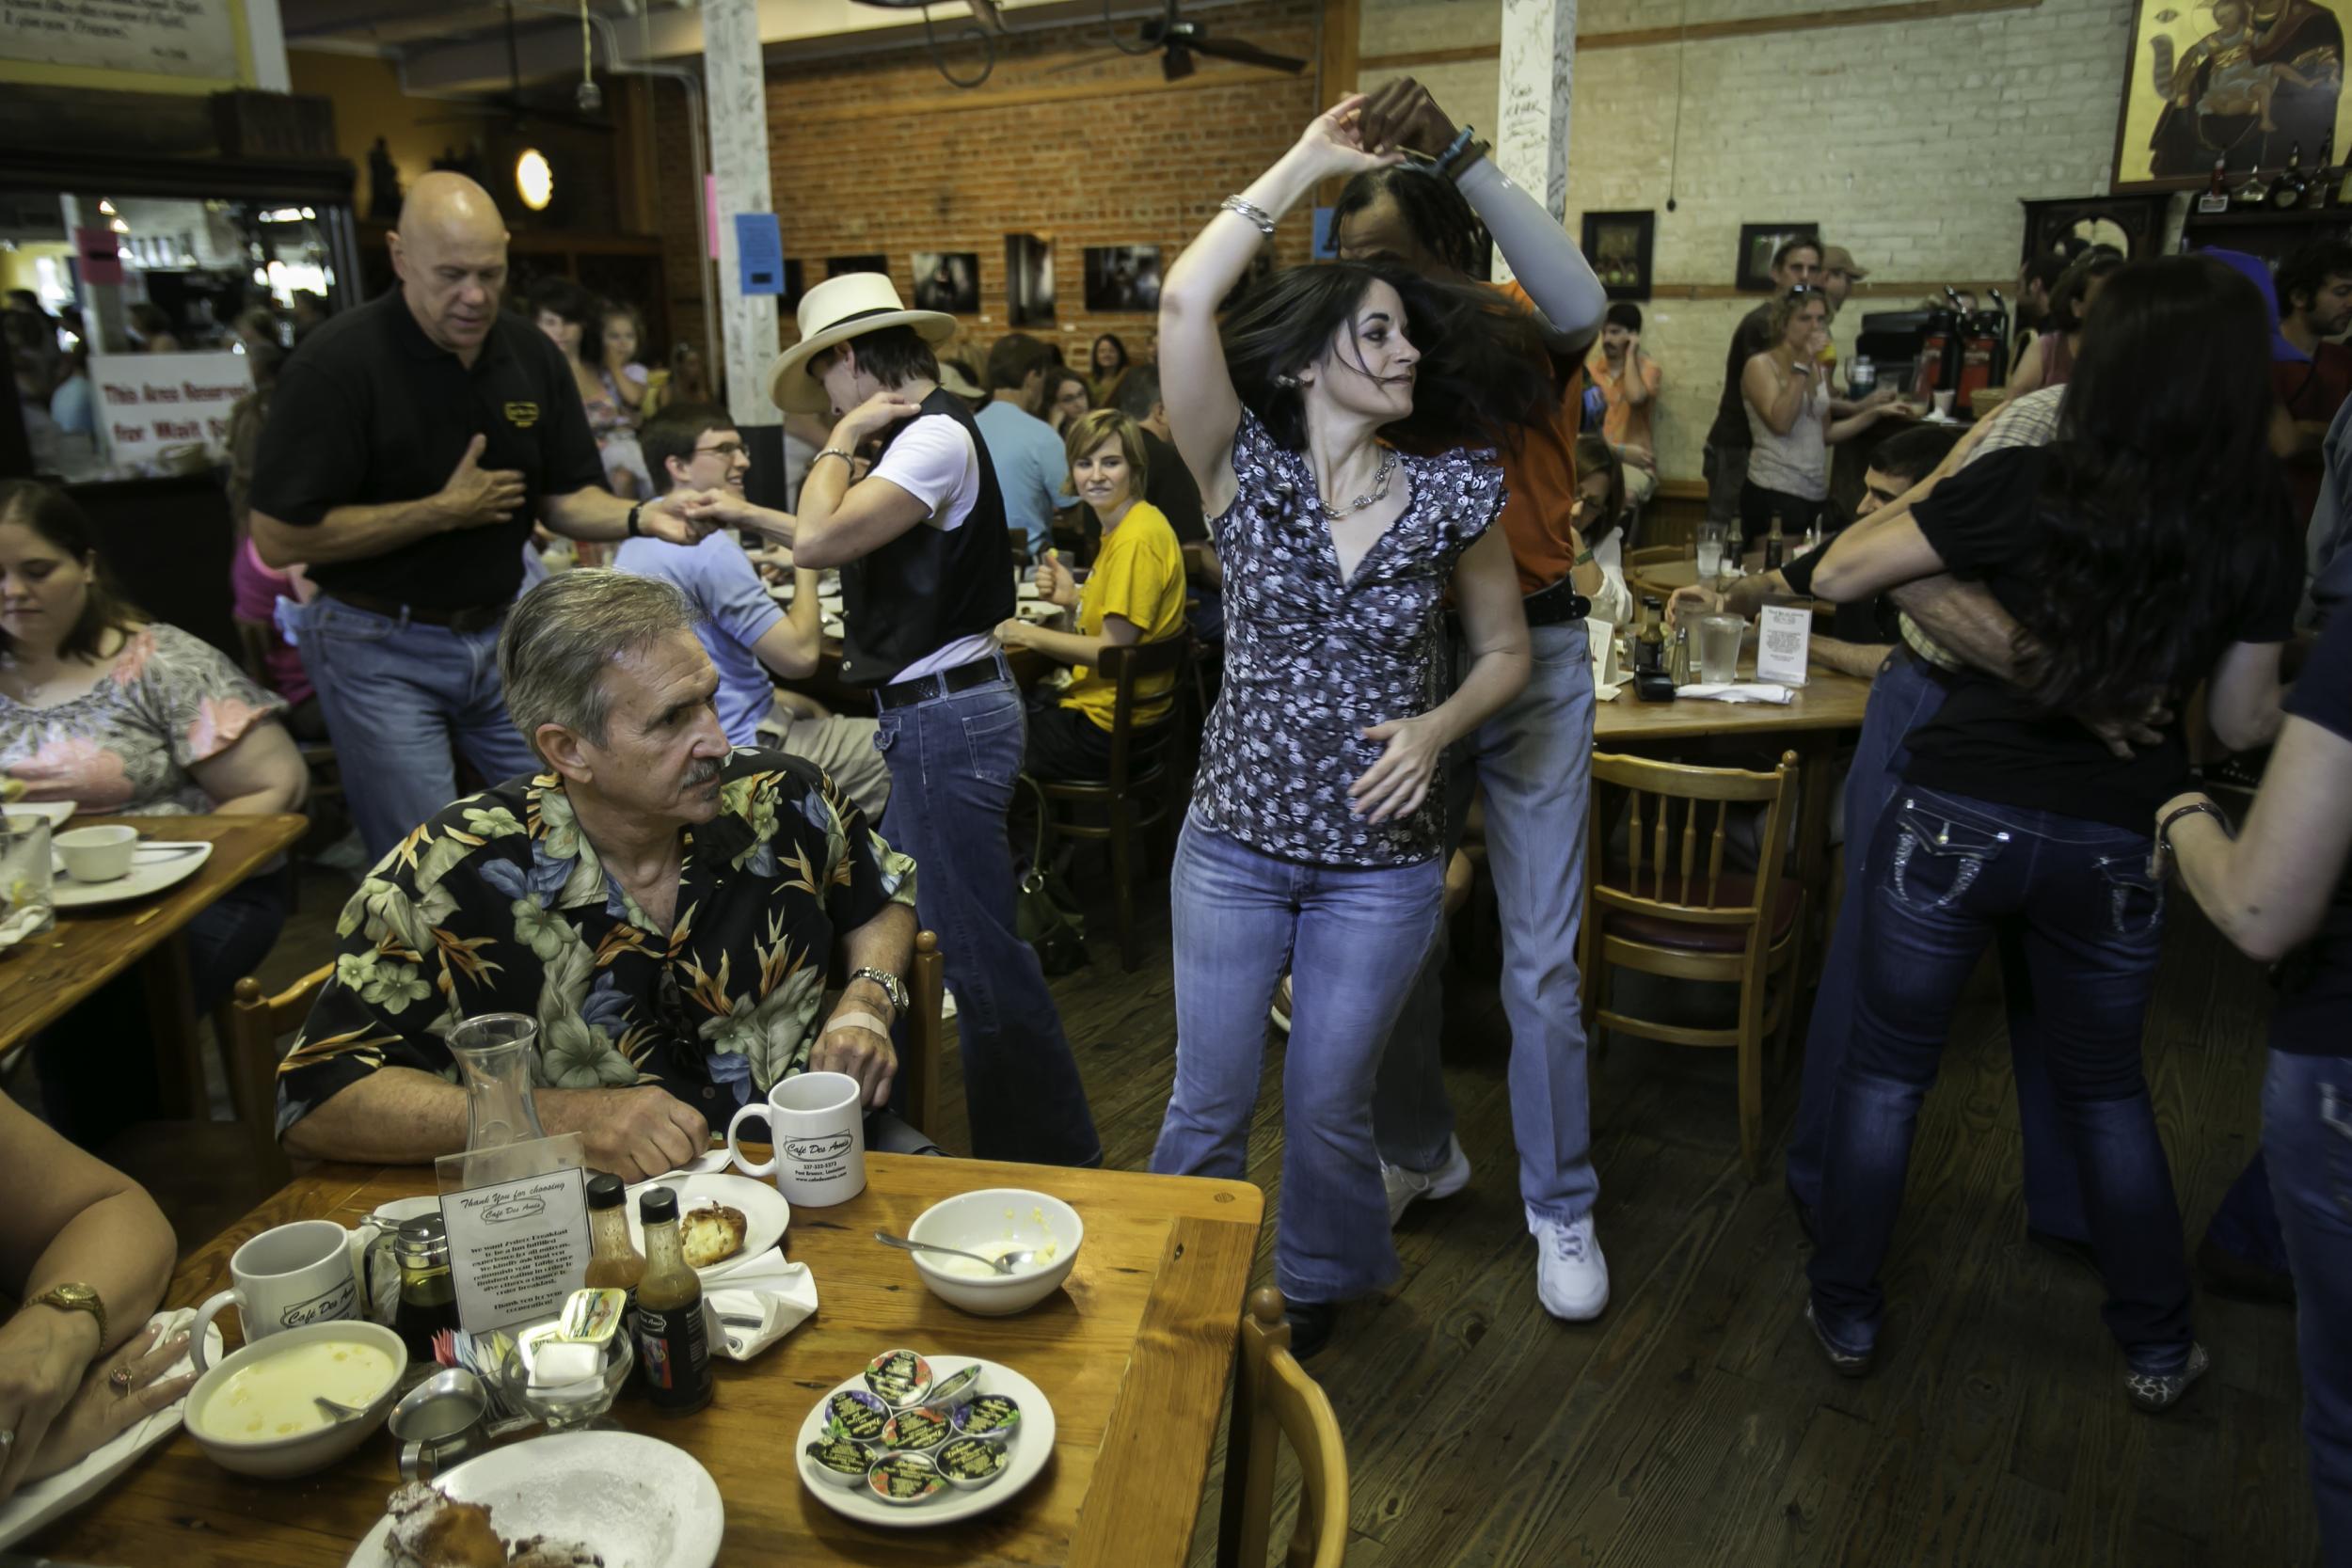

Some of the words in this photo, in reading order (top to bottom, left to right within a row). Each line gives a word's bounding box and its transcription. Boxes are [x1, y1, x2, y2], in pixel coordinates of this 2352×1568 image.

[103, 383, 138, 404] This
[143, 381, 179, 404] Area
[112, 422, 144, 443] for
[152, 420, 201, 439] Wait
[810, 1144, 826, 1154] Des
[829, 1139, 849, 1152] Amis
[461, 1194, 490, 1209] Thank
[492, 1193, 510, 1205] You
[513, 1189, 526, 1201] for
[530, 1181, 565, 1195] choosing
[506, 1205, 519, 1214] Des
[522, 1202, 540, 1211] Amis
[319, 1301, 337, 1314] Des
